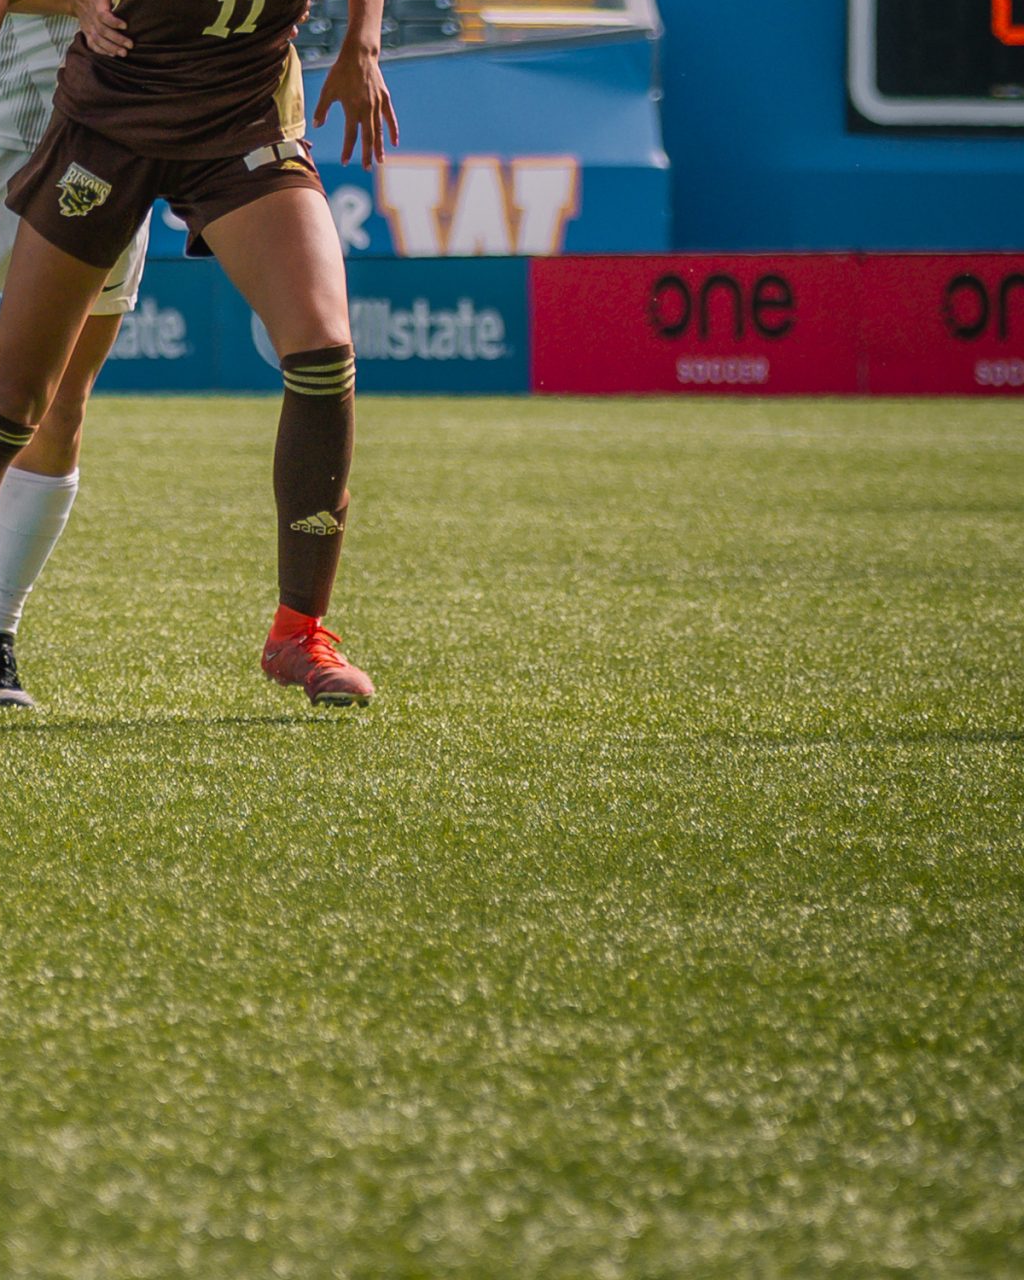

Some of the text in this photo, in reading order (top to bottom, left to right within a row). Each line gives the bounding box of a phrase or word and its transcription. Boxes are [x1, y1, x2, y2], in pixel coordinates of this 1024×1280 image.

[64, 166, 109, 206] BISONS
[349, 299, 505, 360] llstate
[648, 274, 795, 339] one
